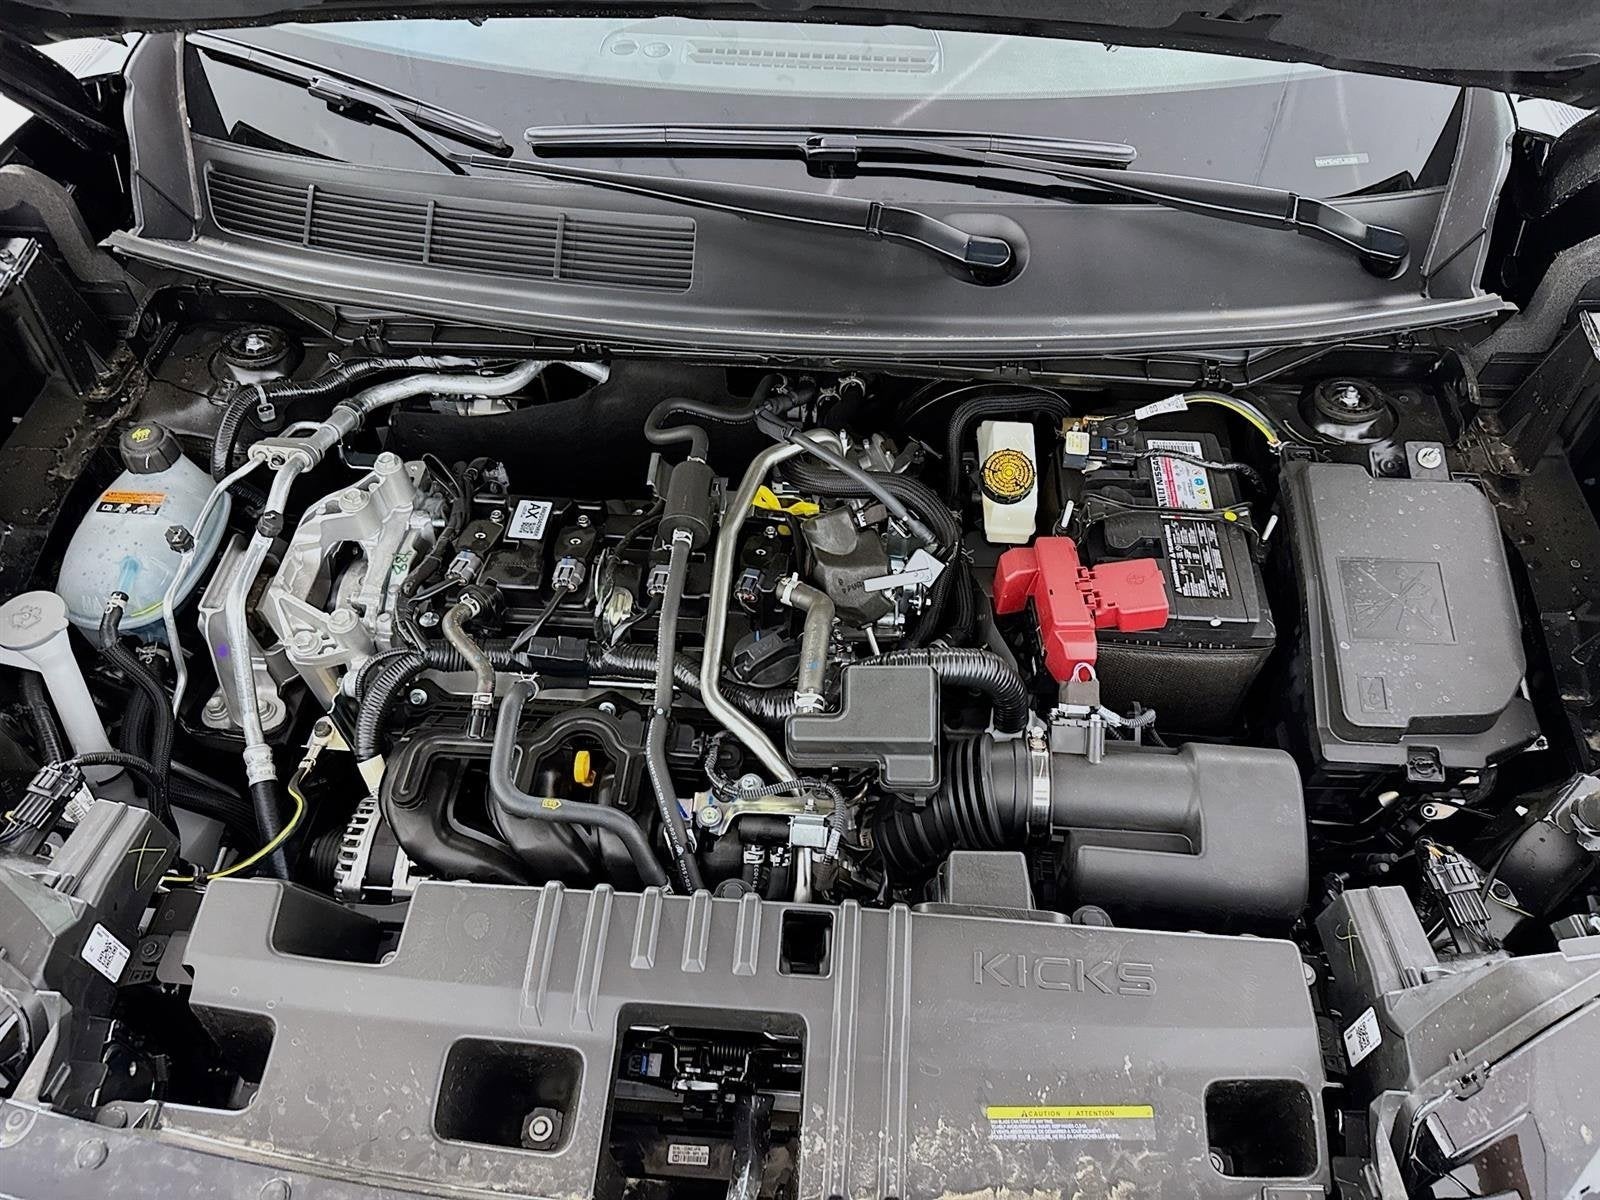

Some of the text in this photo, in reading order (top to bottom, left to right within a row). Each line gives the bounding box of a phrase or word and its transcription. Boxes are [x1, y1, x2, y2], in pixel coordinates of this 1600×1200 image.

[525, 502, 541, 519] AX
[973, 951, 1157, 997] KICKS
[1075, 1109, 1115, 1117] ATTENTION
